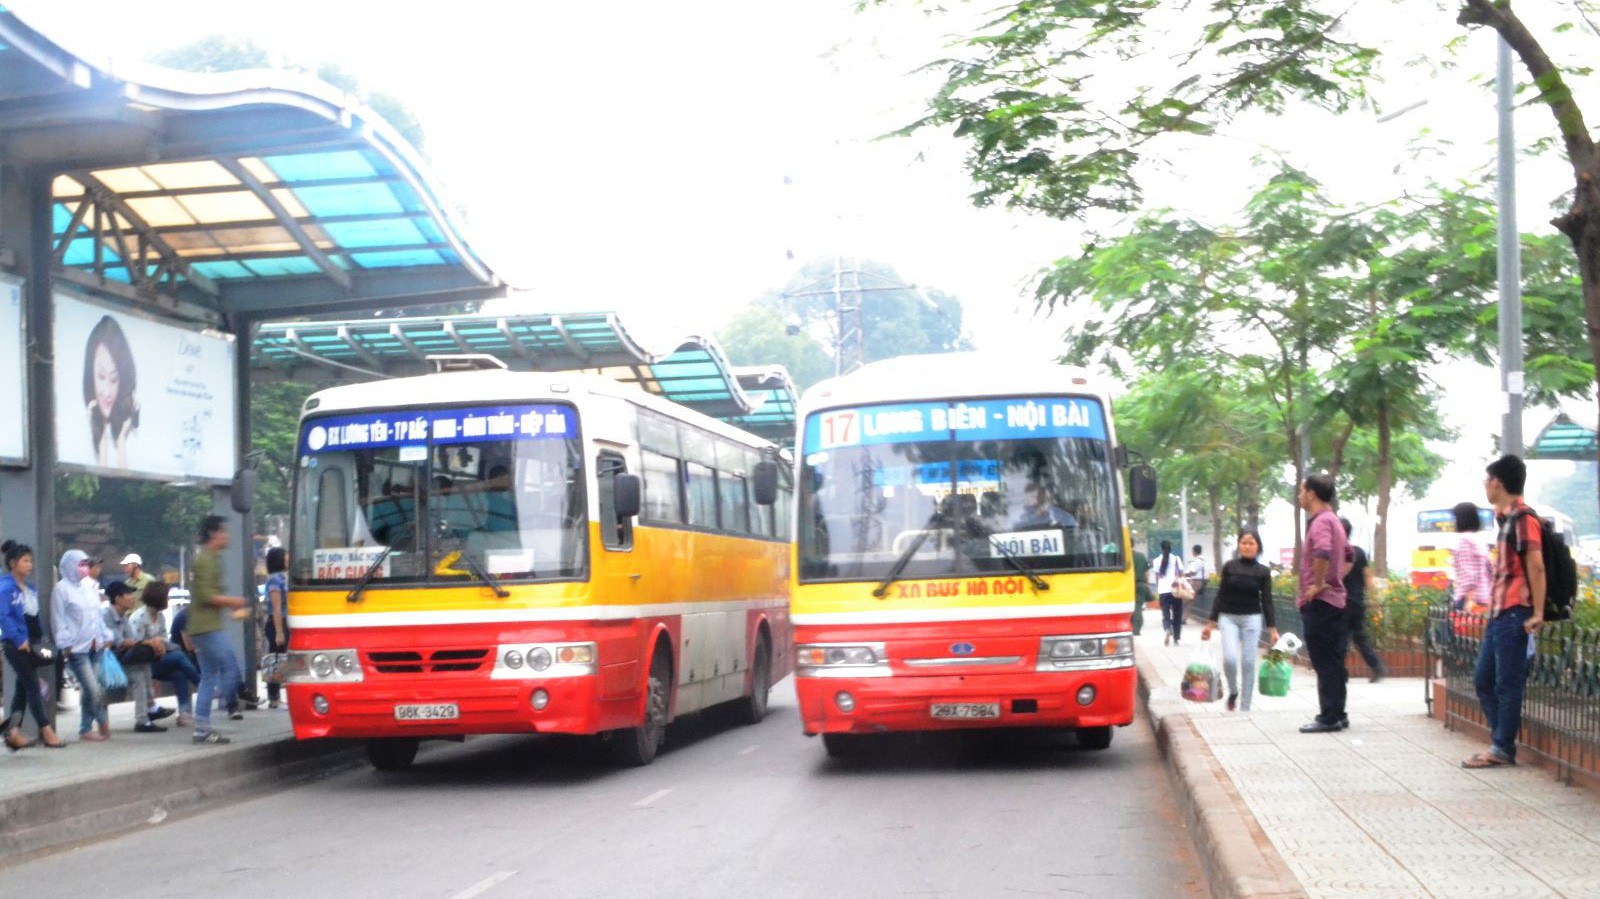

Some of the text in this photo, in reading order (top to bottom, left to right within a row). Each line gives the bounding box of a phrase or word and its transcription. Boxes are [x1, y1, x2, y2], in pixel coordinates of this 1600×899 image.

[823, 413, 855, 444] 17
[930, 402, 987, 431] BIÊN
[1006, 400, 1047, 431] NỘI
[1052, 400, 1090, 428] BÀI
[1030, 534, 1058, 554] BÀI
[926, 580, 961, 598] BUS
[966, 577, 989, 596] HÀ
